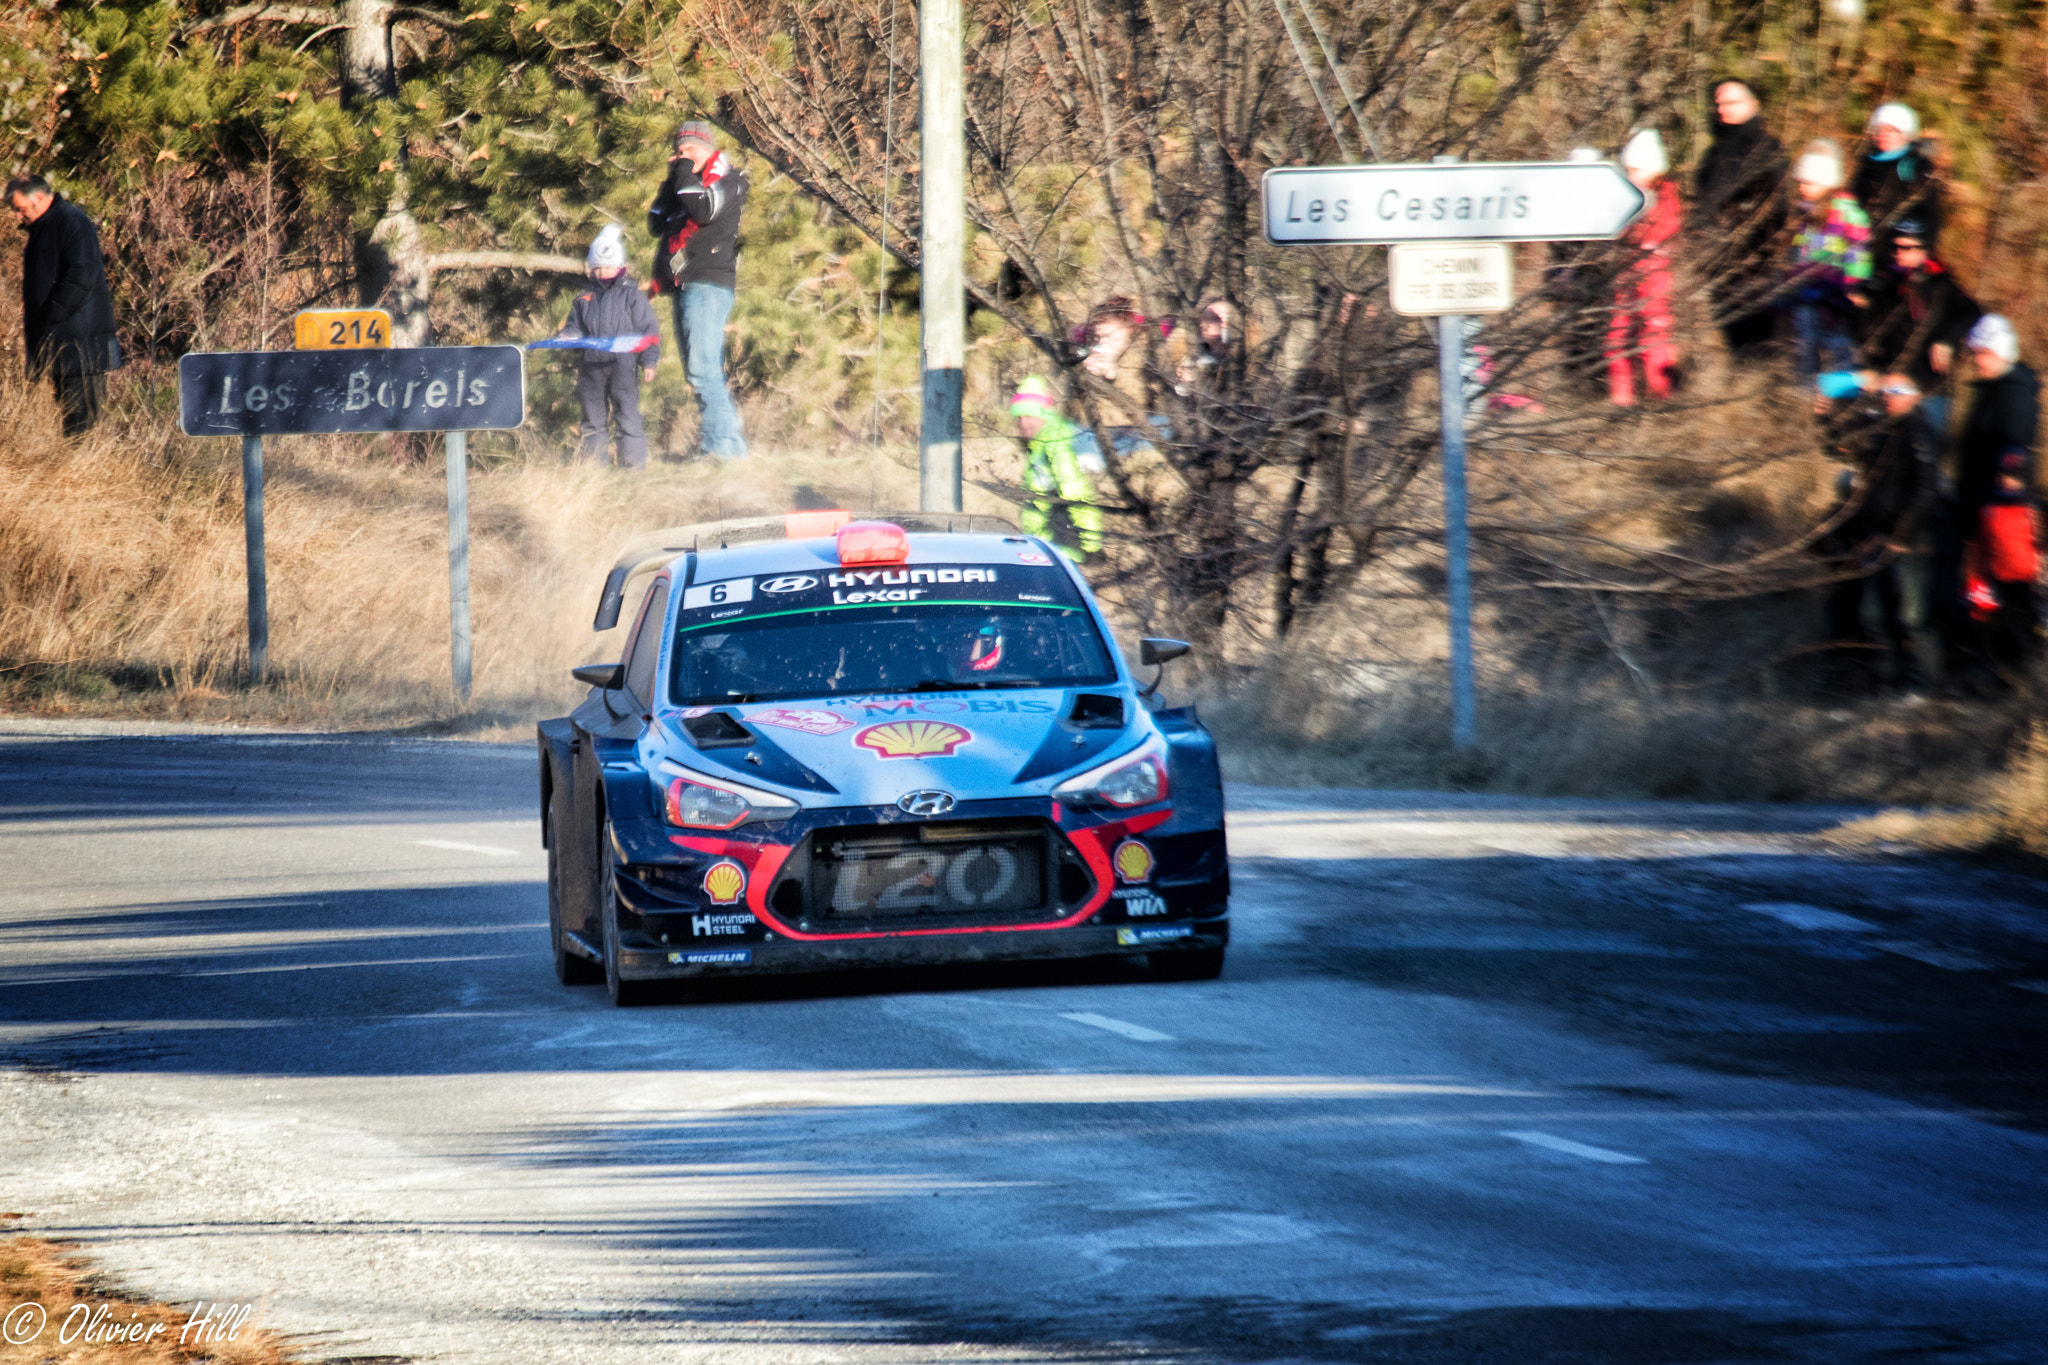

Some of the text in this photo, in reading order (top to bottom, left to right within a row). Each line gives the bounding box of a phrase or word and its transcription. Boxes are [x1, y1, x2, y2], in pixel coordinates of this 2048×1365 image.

[1285, 187, 1529, 223] Les Cesaris
[329, 319, 382, 345] 214
[219, 375, 295, 414] Les
[828, 568, 998, 588] HYUNDAI
[710, 584, 727, 604] 6
[832, 588, 925, 605] Lexar
[864, 699, 1056, 717] MOBIS
[1126, 897, 1168, 917] WIA
[711, 914, 756, 924] HYUNDAI
[712, 925, 745, 935] STEEL
[687, 952, 747, 963] MICHELIN
